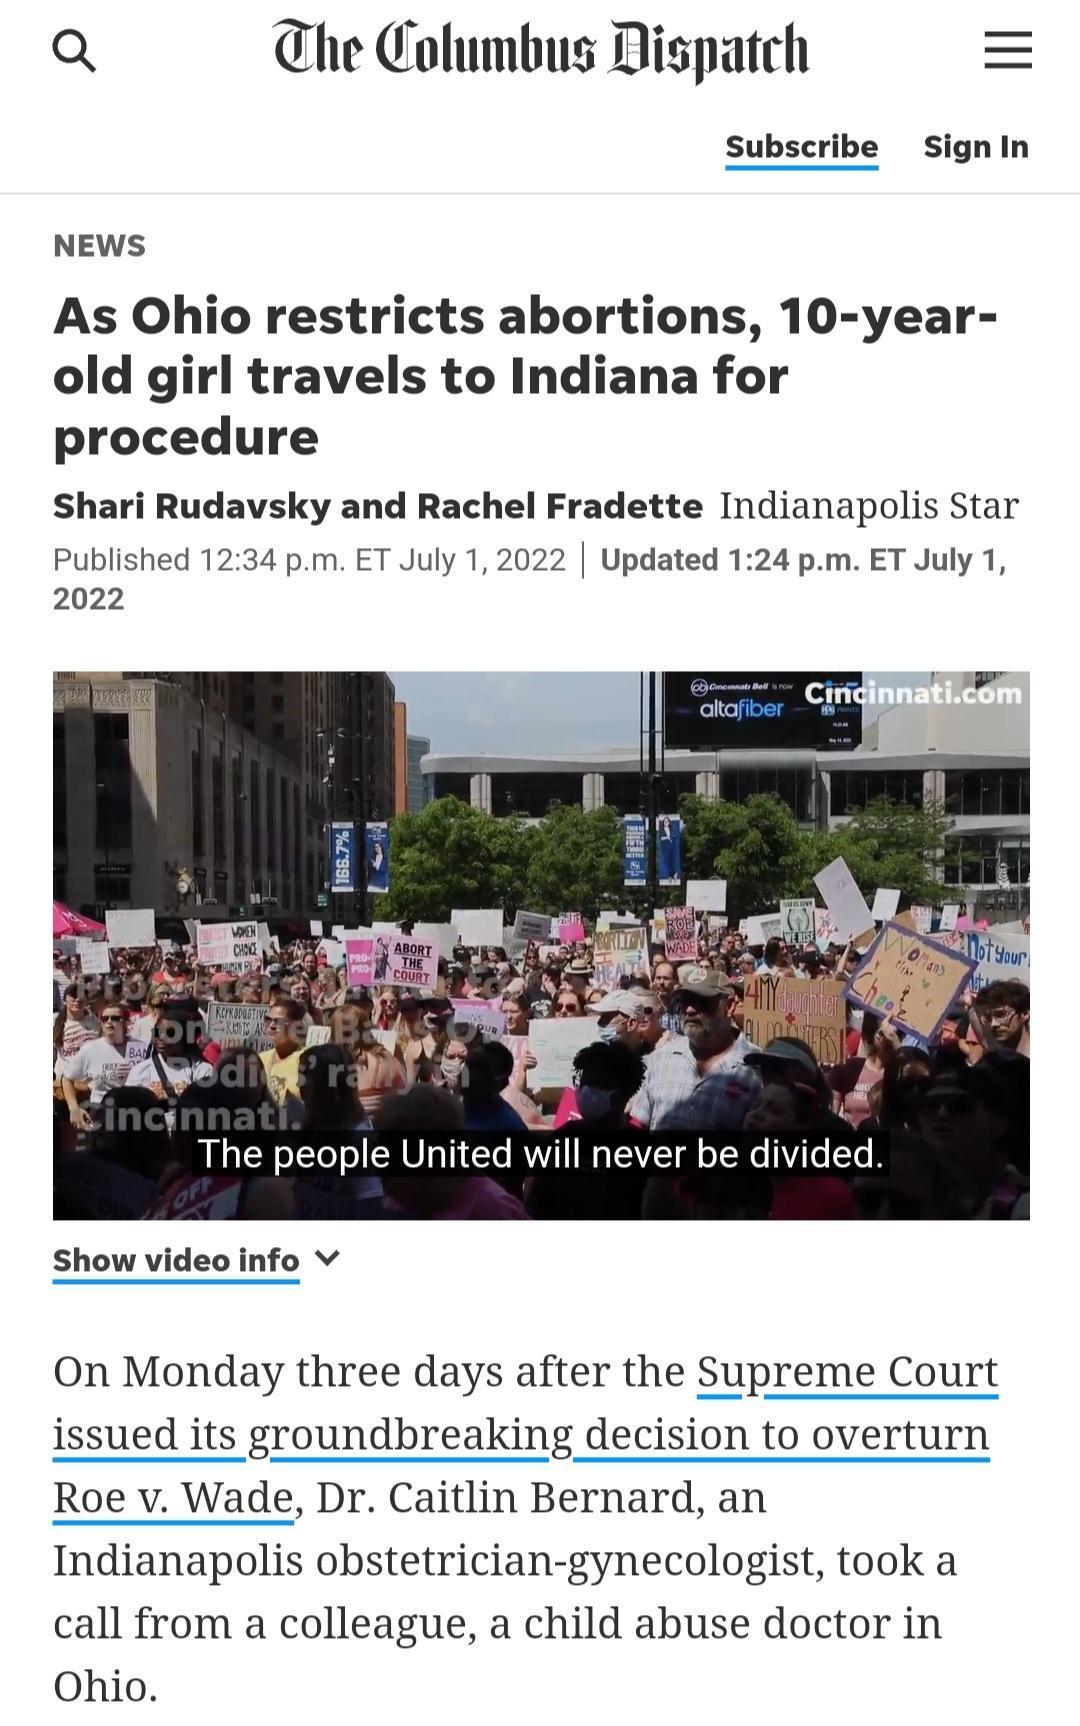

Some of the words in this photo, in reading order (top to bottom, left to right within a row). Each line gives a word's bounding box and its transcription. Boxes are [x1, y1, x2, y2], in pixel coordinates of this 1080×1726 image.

[273, 18, 363, 73] The
[376, 19, 597, 73] Columbus
[607, 20, 809, 86] Dispatch
[727, 133, 878, 158] Subscribe
[925, 133, 990, 164] Sign
[1002, 135, 1028, 158] In
[55, 234, 145, 257] NEWS
[54, 297, 116, 334] As
[133, 294, 250, 334] Ohio
[268, 294, 484, 334] restricts
[500, 294, 760, 343] abortions,
[780, 296, 996, 344] 10-year-
[54, 354, 131, 394] old
[148, 354, 231, 404] girl
[247, 354, 426, 394] travels
[441, 358, 495, 394] to
[513, 354, 697, 394] Indiana
[713, 354, 788, 394] for
[56, 415, 318, 465] procedure
[54, 491, 144, 519] Shari
[157, 491, 331, 526] Rudavsky
[342, 491, 405, 519] and
[419, 491, 534, 519] Rachel
[548, 491, 703, 519] Fradette
[721, 490, 938, 528] Indianapolis
[951, 492, 1019, 519] Star
[54, 547, 190, 570] Published
[201, 548, 276, 570] 12:34
[287, 553, 345, 576] p.m.
[357, 548, 391, 570] ET
[400, 547, 456, 576] July
[467, 549, 487, 575] 1,
[498, 549, 566, 570] 2022
[602, 548, 717, 576] Updated
[730, 549, 789, 570] 1:24
[800, 553, 859, 576] p.m.
[871, 549, 906, 570] ET
[914, 548, 972, 576] July
[983, 549, 1006, 575] 1,
[54, 588, 124, 609] 2022
[709, 683, 750, 691] Cincinnati
[752, 682, 769, 690] Bell
[700, 699, 784, 721] altafiber
[336, 830, 350, 885] 166.7%
[231, 925, 256, 938] WOMEN
[233, 942, 257, 957] CHOICE
[349, 954, 371, 963] PRO-
[394, 943, 432, 956] ABORT
[667, 940, 695, 953] WADE
[351, 964, 371, 973] PRO-
[393, 970, 430, 983] COURT
[401, 957, 423, 969] THE
[54, 1247, 136, 1272] Show
[145, 1247, 230, 1272] video
[240, 1247, 299, 1272] info
[55, 1356, 110, 1387] On
[123, 1354, 285, 1397] Monday
[296, 1354, 400, 1387] three
[415, 1354, 502, 1396] days
[517, 1354, 610, 1387] after
[623, 1354, 684, 1387] the
[699, 1356, 874, 1395] Supreme
[890, 1356, 998, 1387] Court
[53, 1417, 178, 1449] issued
[191, 1417, 235, 1449] its
[247, 1417, 574, 1459] groundbreaking
[587, 1417, 749, 1449] decision
[762, 1421, 798, 1449] to
[813, 1421, 989, 1450] overturn
[54, 1482, 125, 1512] Roe
[138, 1489, 167, 1512] v.
[181, 1480, 302, 1518] Wade,
[317, 1482, 374, 1512] Dr.
[390, 1480, 517, 1513] Caitlin
[531, 1480, 704, 1519] Bernard,
[719, 1489, 766, 1512] an
[54, 1543, 302, 1585] Indianapolis
[317, 1543, 823, 1585] obstetrician-gynecologist,
[837, 1543, 924, 1576] took
[937, 1552, 957, 1576] a
[55, 1606, 122, 1639] call
[135, 1606, 232, 1639] from
[246, 1615, 266, 1639] a
[281, 1606, 475, 1648] colleague,
[491, 1615, 511, 1638] a
[526, 1606, 622, 1639] child
[636, 1606, 749, 1639] abuse
[765, 1606, 891, 1639] doctor
[904, 1606, 942, 1639] in
[55, 1669, 156, 1702] Ohio.
